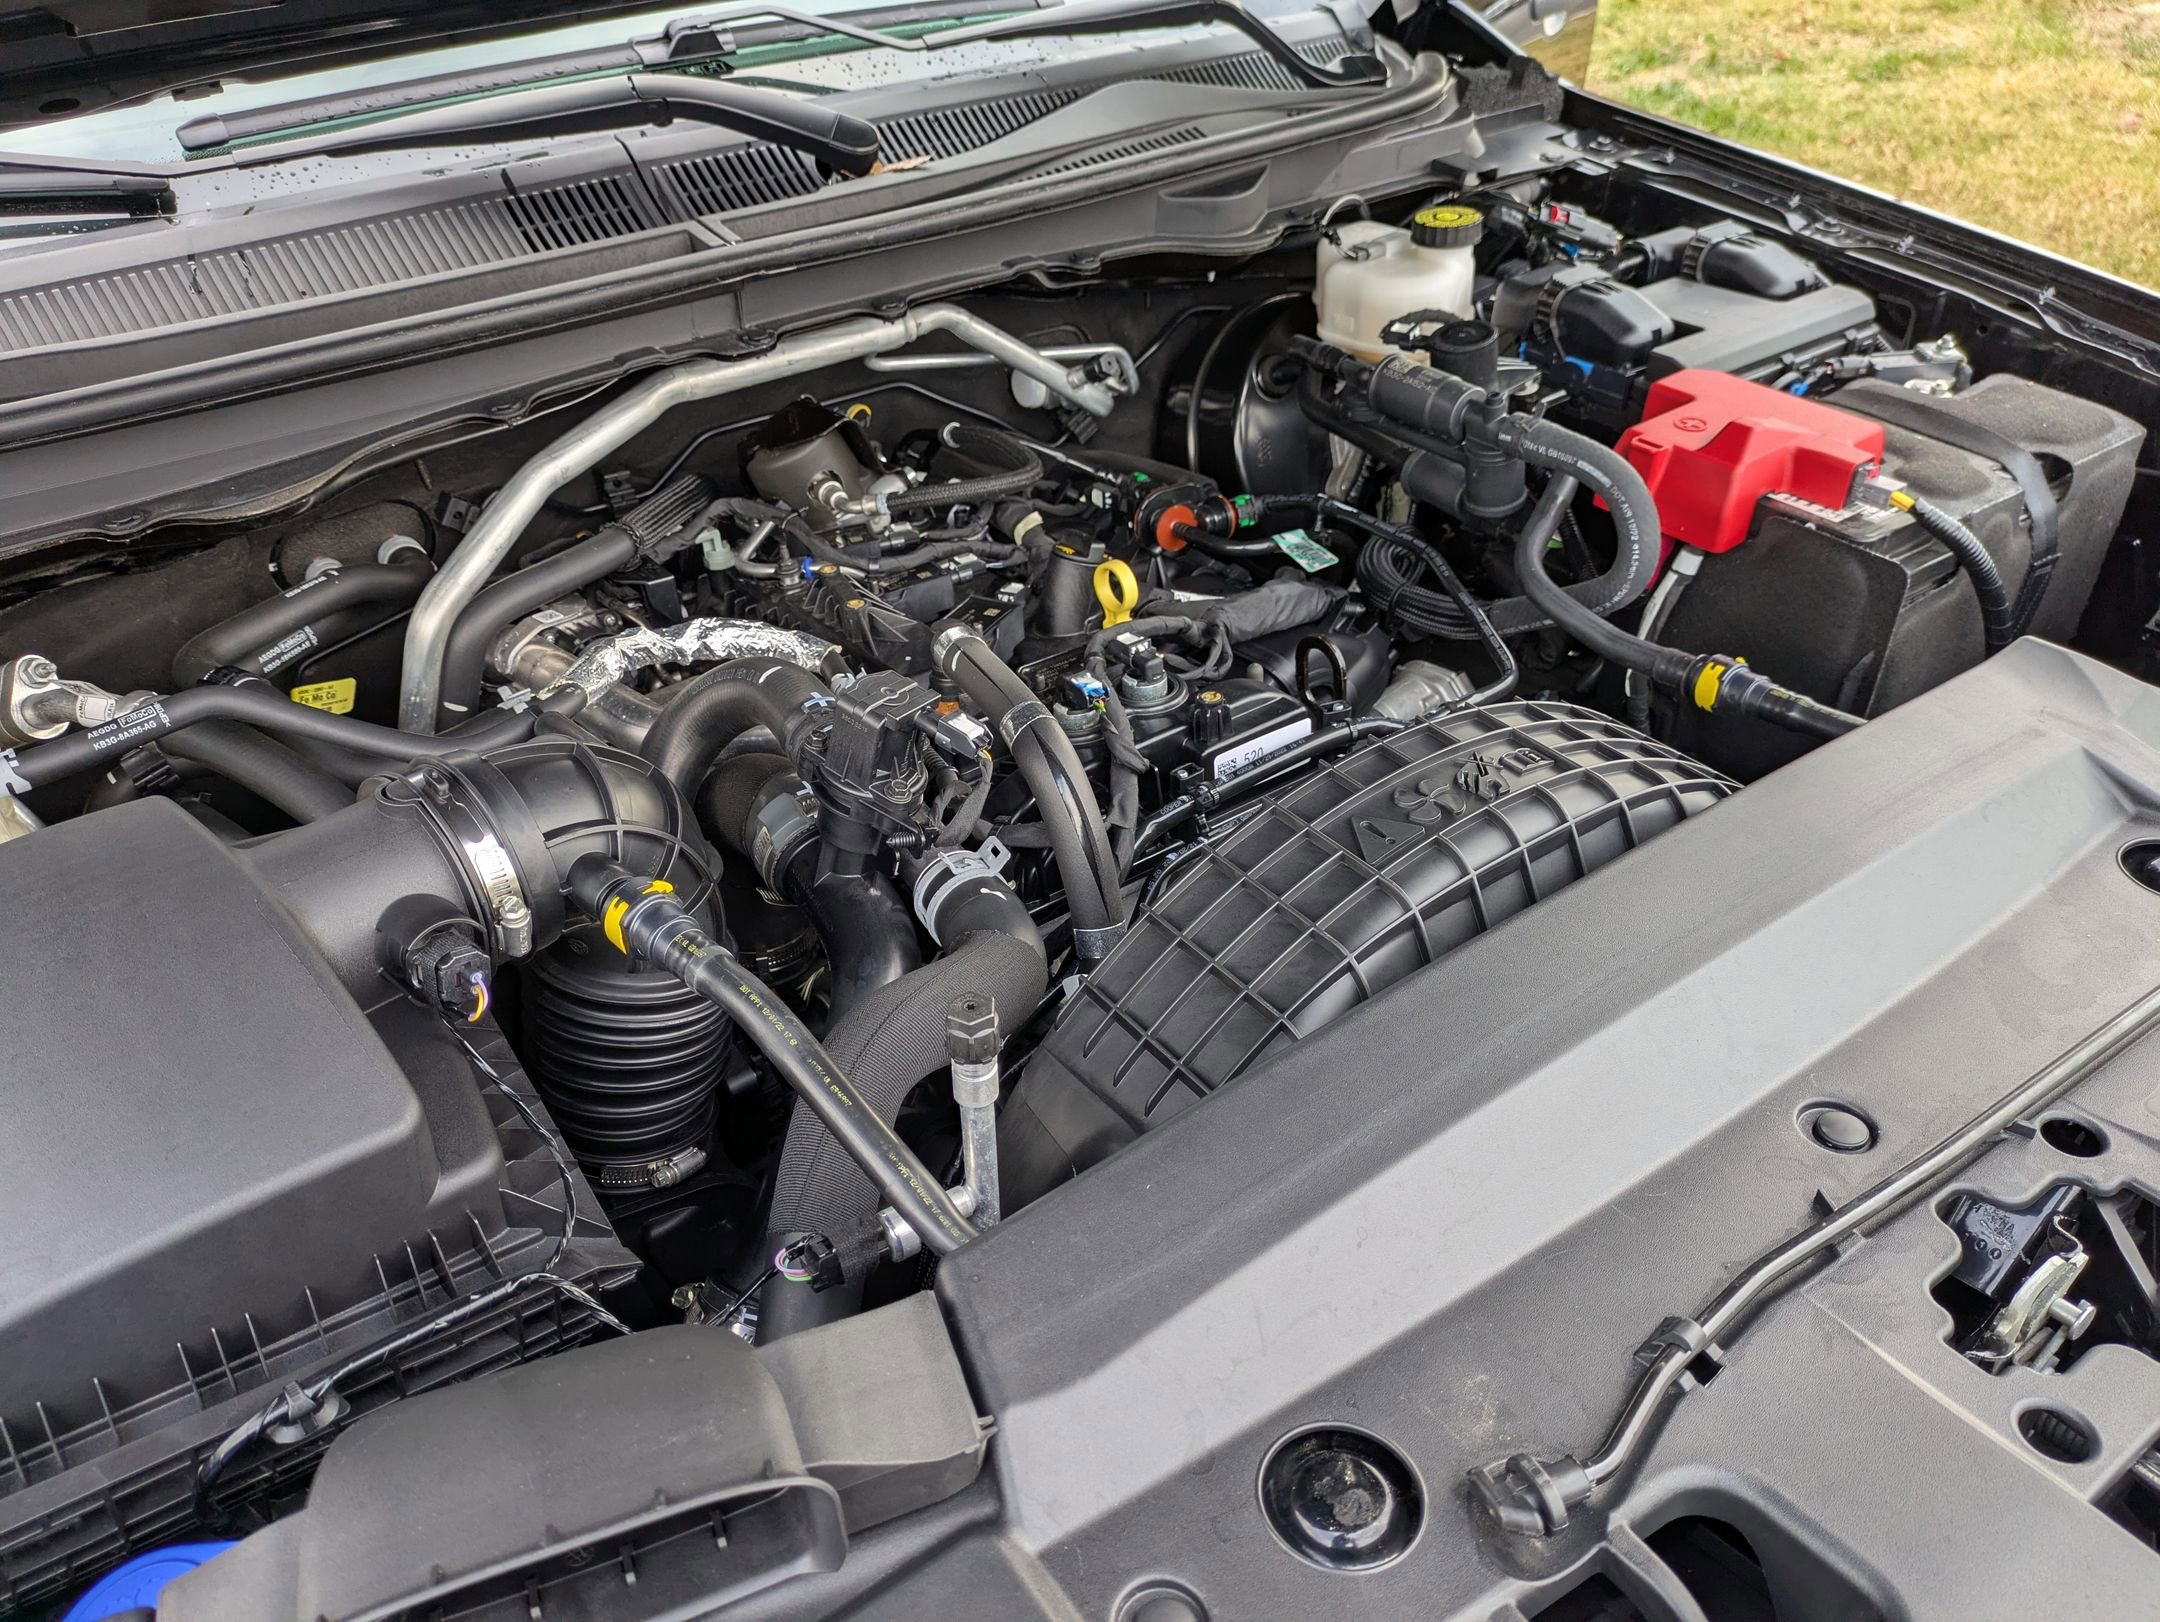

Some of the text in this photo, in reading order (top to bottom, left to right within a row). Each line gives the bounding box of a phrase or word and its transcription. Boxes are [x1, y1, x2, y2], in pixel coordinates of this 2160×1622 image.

[87, 723, 118, 740] AEGDG
[120, 706, 154, 726] FoMoCo
[92, 719, 158, 752] KB3G-8A365-AG
[1243, 746, 1265, 763] 520
[1160, 799, 1183, 817] COOPER
[762, 1007, 785, 1032] 12/01/22
[907, 1177, 934, 1205] 12/01/22
